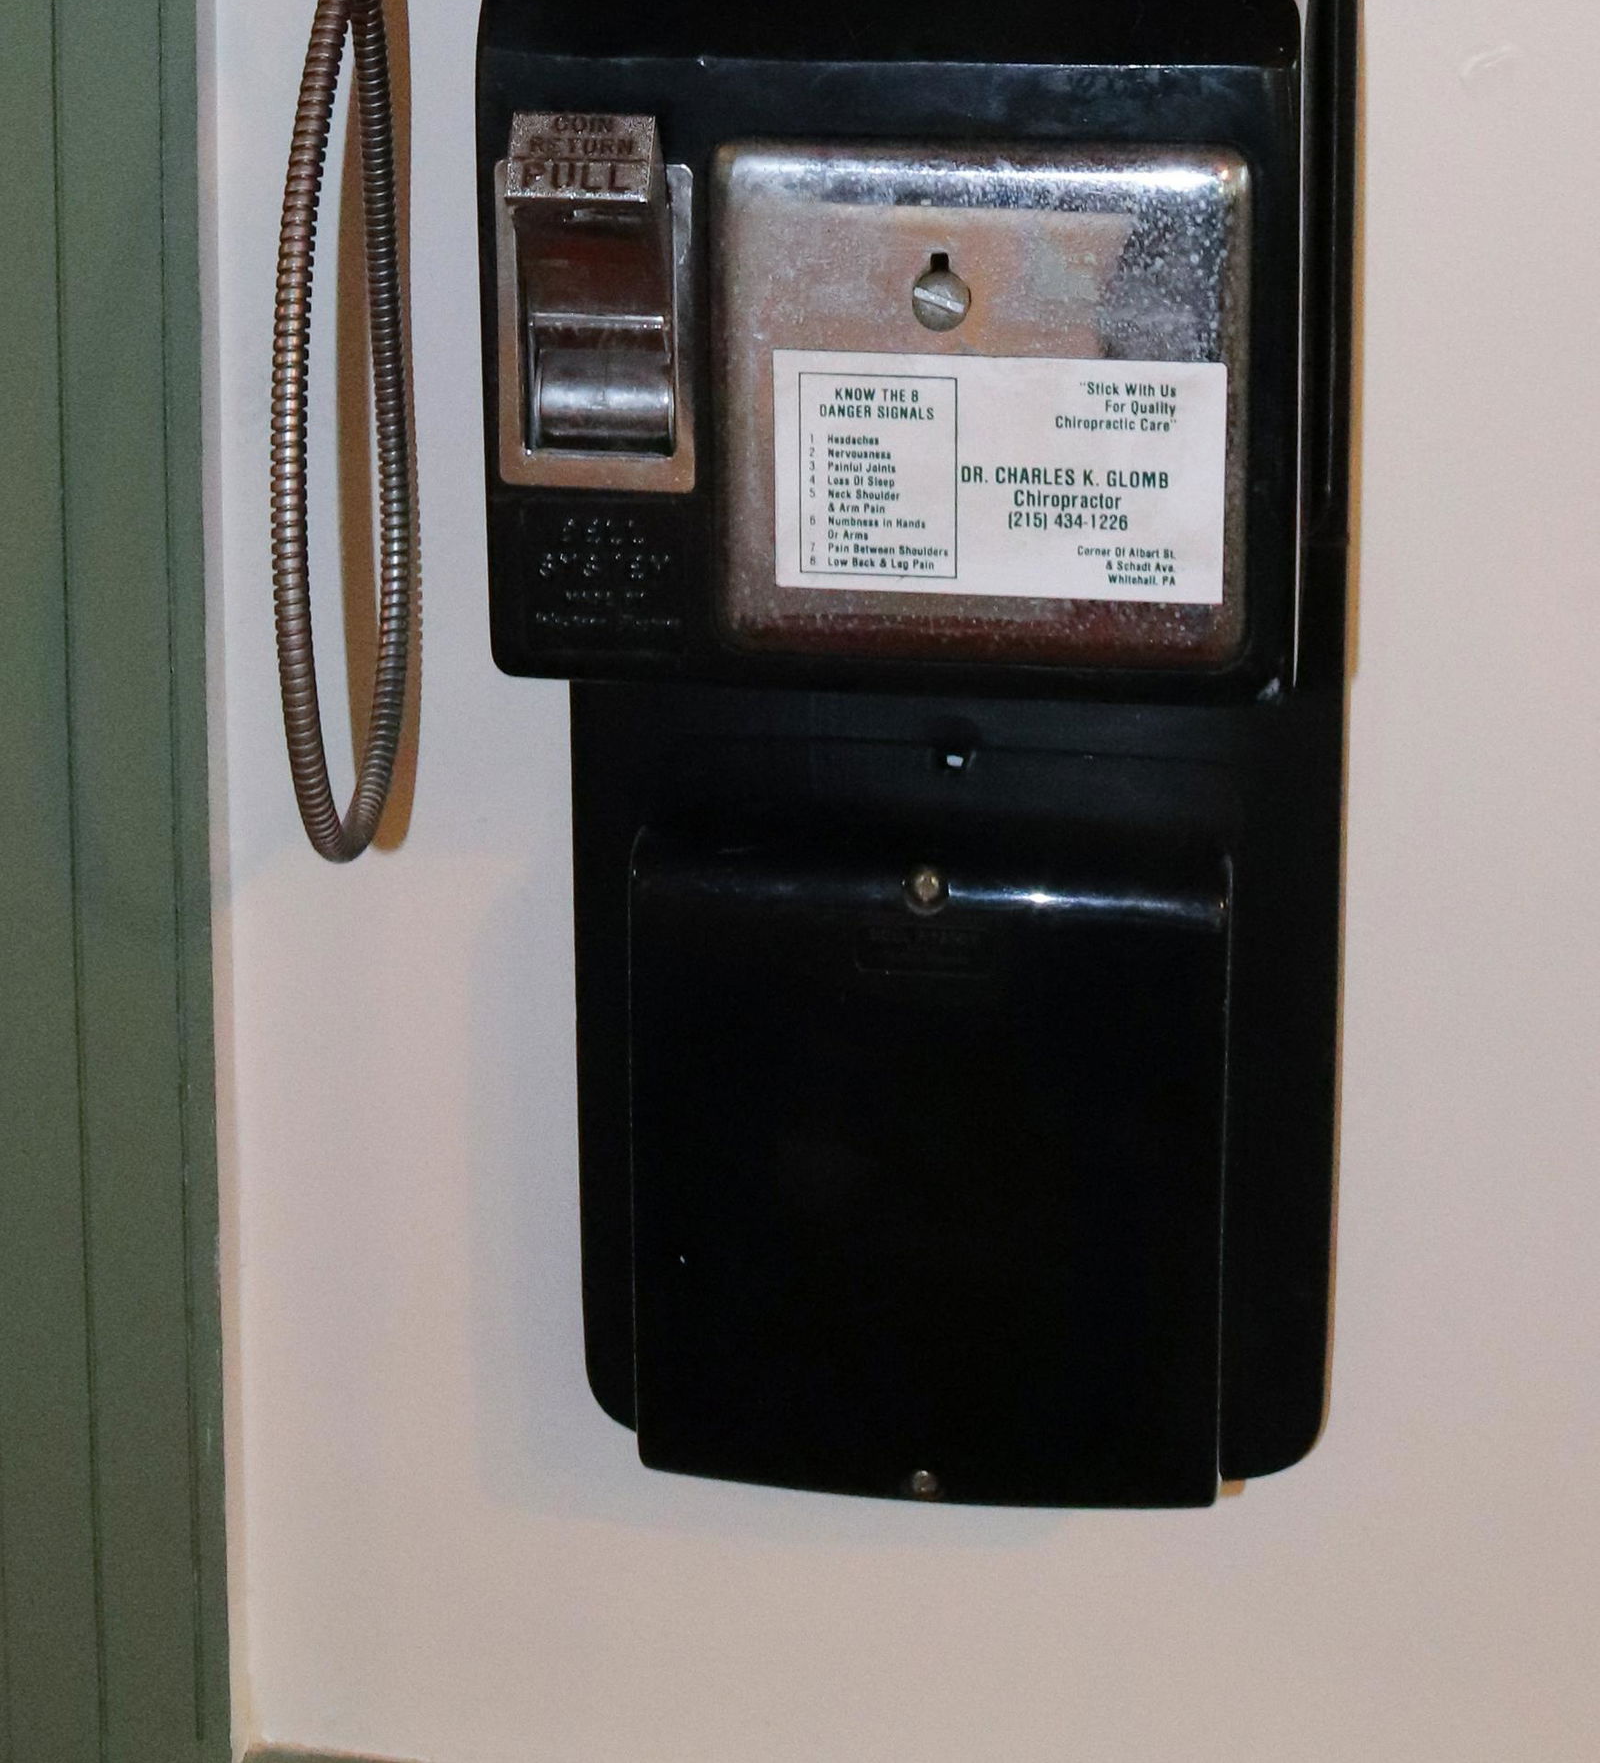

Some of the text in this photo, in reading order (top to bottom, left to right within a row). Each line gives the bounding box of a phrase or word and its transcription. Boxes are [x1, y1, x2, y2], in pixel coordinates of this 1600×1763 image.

[554, 115, 614, 133] COIN
[529, 137, 634, 154] RETURN
[522, 161, 633, 192] PULL
[835, 387, 919, 403] KNOW THE 8
[1125, 382, 1155, 397] With
[1160, 384, 1177, 398] Us
[819, 404, 935, 420] DANGER SIGNALS
[1105, 399, 1177, 416] For Quality
[1055, 415, 1136, 432] Chiropractic
[827, 434, 880, 446] Headaches
[827, 447, 892, 460] Nervousness
[827, 461, 863, 473] Painful
[865, 462, 897, 474] Joints
[827, 475, 850, 486] Loss
[853, 476, 864, 486] Of
[868, 476, 895, 489] Sleep
[961, 465, 1169, 489] DR. CHARLES K. GLOMB
[827, 489, 851, 499] Neck
[855, 489, 900, 501] Shoulder
[1014, 489, 1122, 511] Chiropractor
[827, 503, 886, 514] & Arm Pain
[827, 516, 879, 528] Numbness
[896, 518, 926, 529] Hands
[1008, 511, 1129, 532] (215) 434-1226
[827, 530, 869, 541] Or Arms
[827, 543, 849, 553] Pain
[853, 543, 895, 555] Between
[899, 545, 949, 557] Shoulders
[1077, 545, 1111, 556] Corner
[1129, 547, 1160, 558] Albert
[827, 557, 935, 571] Low Back & Leg Pain
[1105, 560, 1113, 570] &
[1117, 561, 1151, 572] Schadt
[1162, 575, 1176, 586] PA
